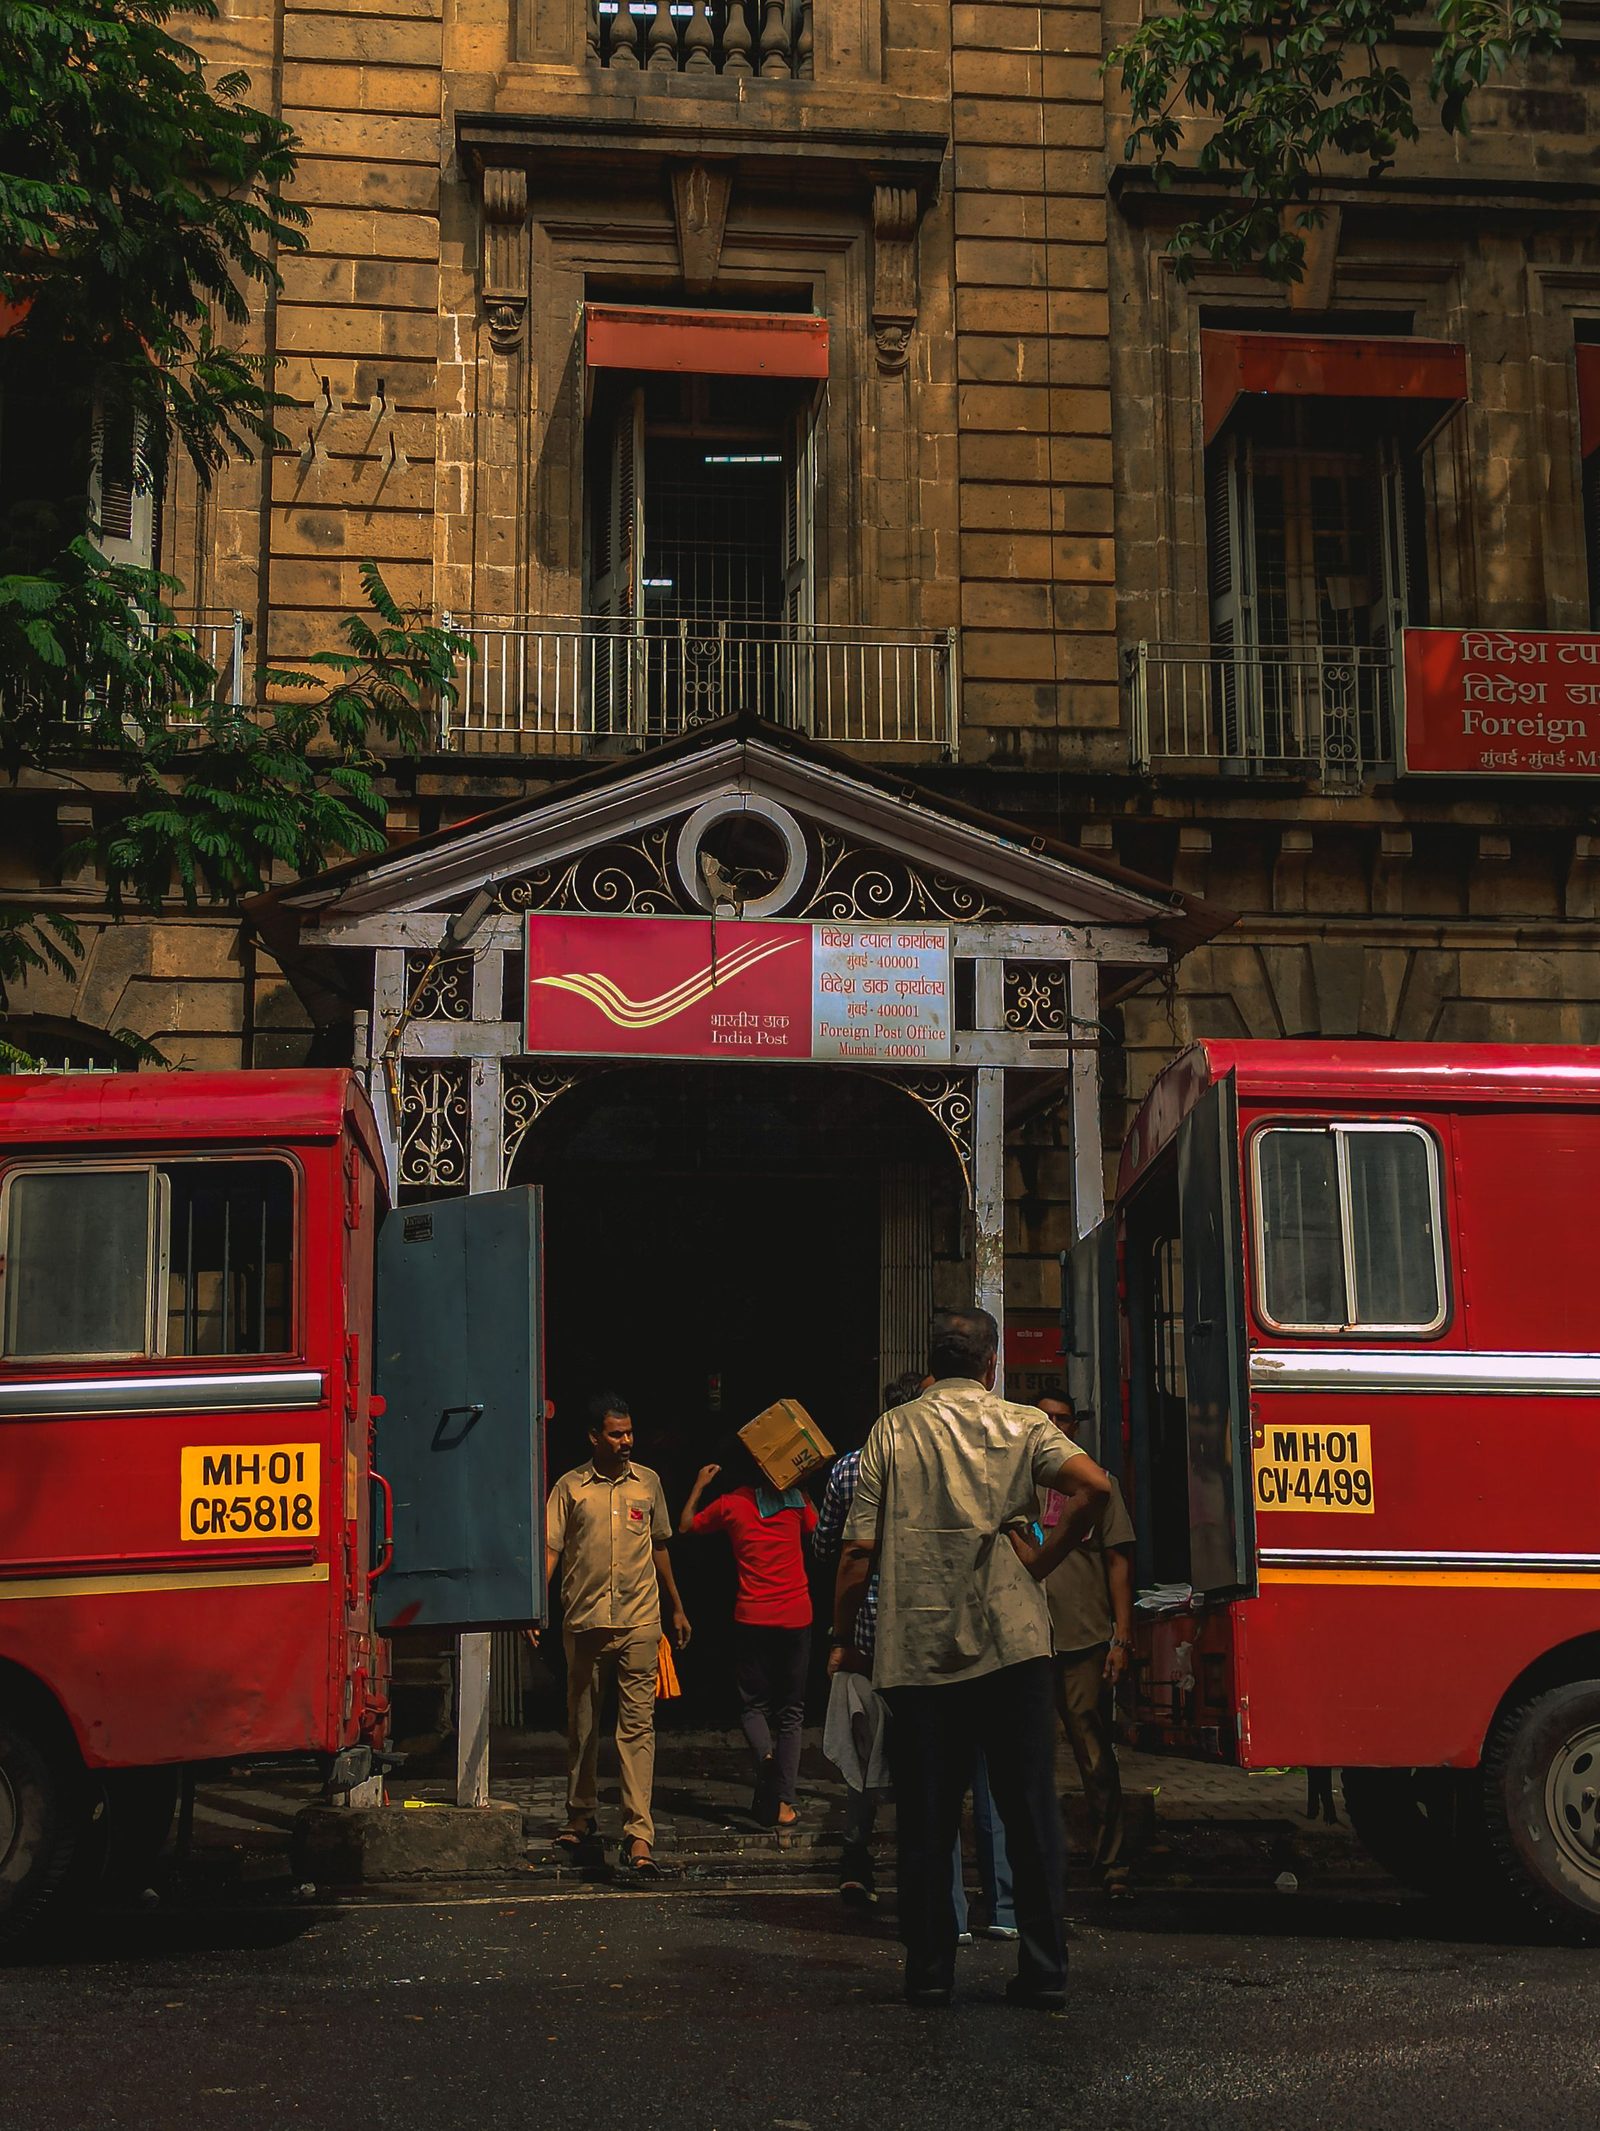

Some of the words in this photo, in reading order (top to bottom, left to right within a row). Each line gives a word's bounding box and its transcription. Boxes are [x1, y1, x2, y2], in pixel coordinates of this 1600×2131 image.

[1460, 632, 1549, 664] विदेश
[1462, 672, 1549, 705] विदेश
[1563, 683, 1600, 705] डा
[1461, 709, 1588, 744] Foreign
[820, 926, 854, 947] विदेश
[859, 932, 892, 948] टपाल
[897, 929, 946, 949] कार्यालय
[877, 955, 920, 969] 400001
[820, 972, 856, 993] विदेश
[862, 978, 889, 993] डाक
[894, 975, 946, 995] कार्यालय
[710, 1010, 760, 1028] भारतीय
[762, 1015, 790, 1029] डाक
[877, 1004, 919, 1017] 400001
[711, 1030, 752, 1044] India
[756, 1031, 789, 1045] Post
[819, 1022, 870, 1041] Foreign
[874, 1024, 901, 1039] Post
[906, 1025, 946, 1040] Office
[839, 1041, 877, 1057] Mumbai
[884, 1044, 926, 1058] 400001
